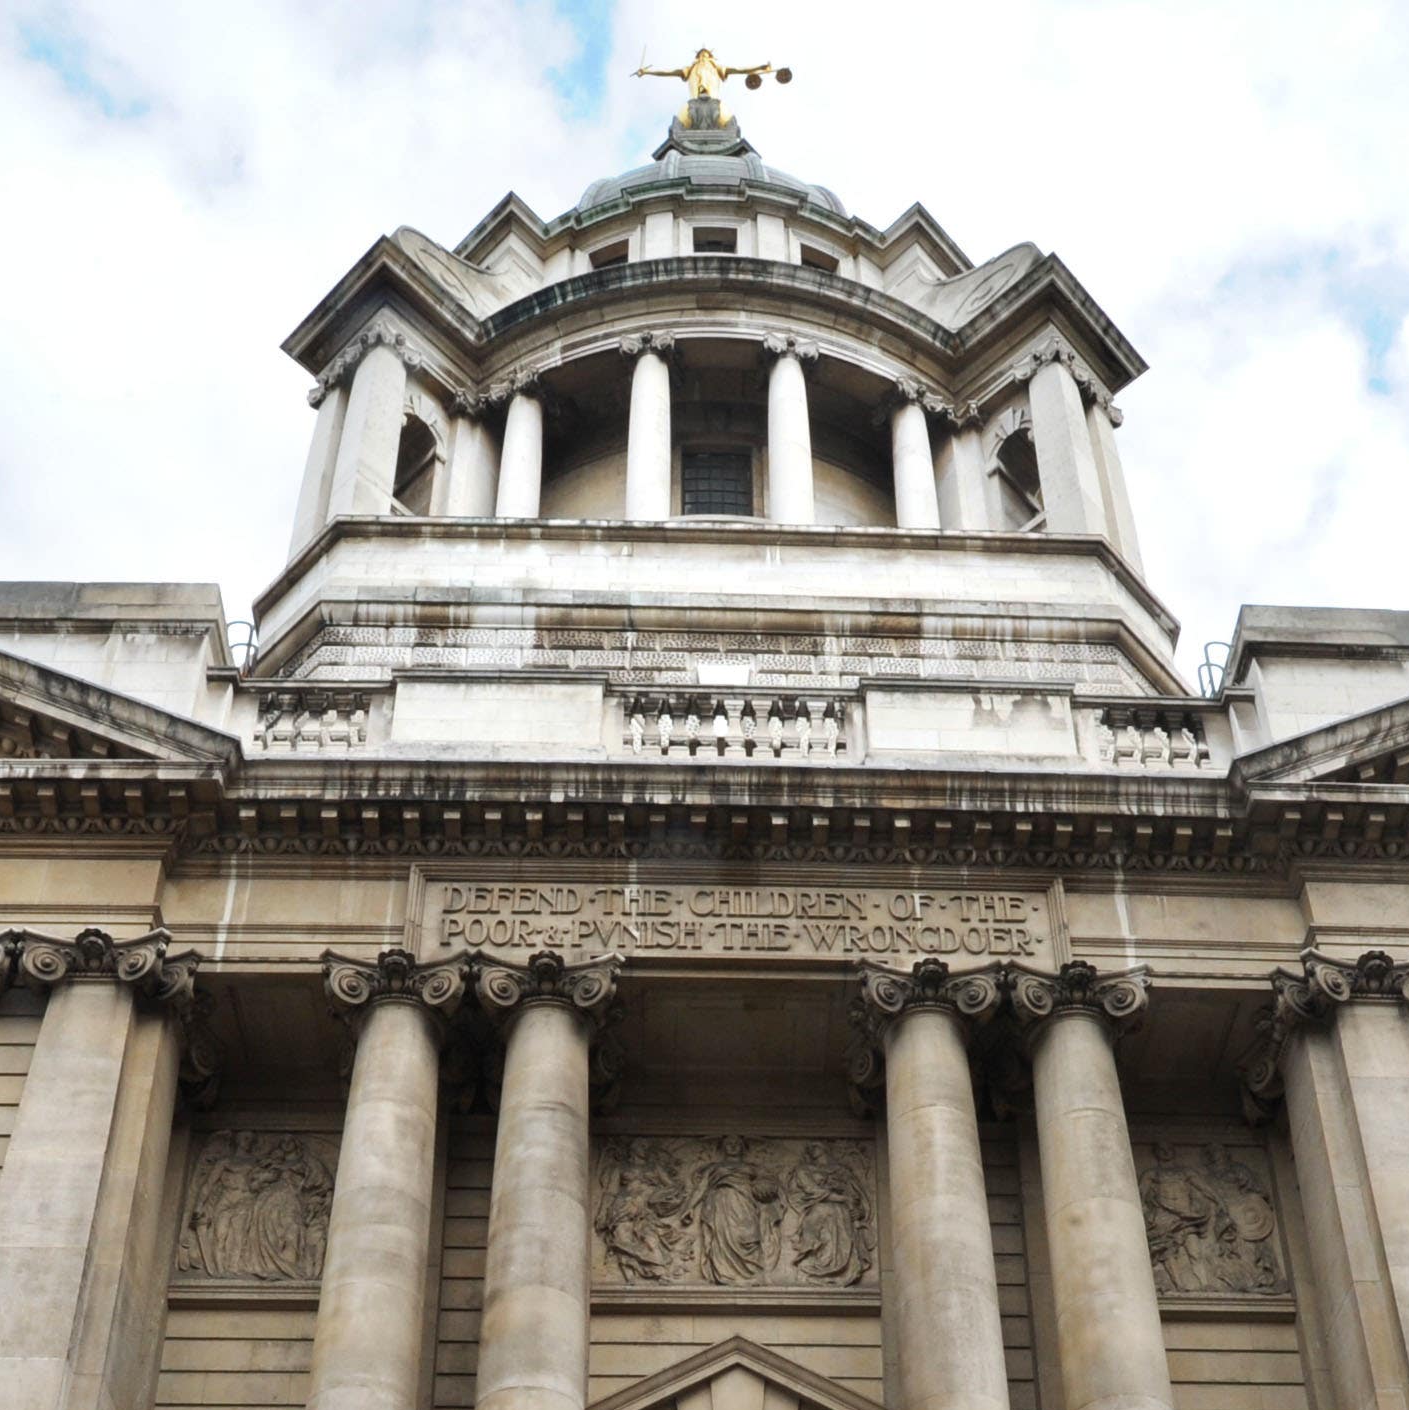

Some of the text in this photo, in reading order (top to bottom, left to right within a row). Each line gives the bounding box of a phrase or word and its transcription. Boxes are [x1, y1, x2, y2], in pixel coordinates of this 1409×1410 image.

[442, 887, 1028, 923] DEFEND THE CHILDREN OF THE
[440, 918, 1035, 956] POOR & PVNISH THE WRONGDOER
